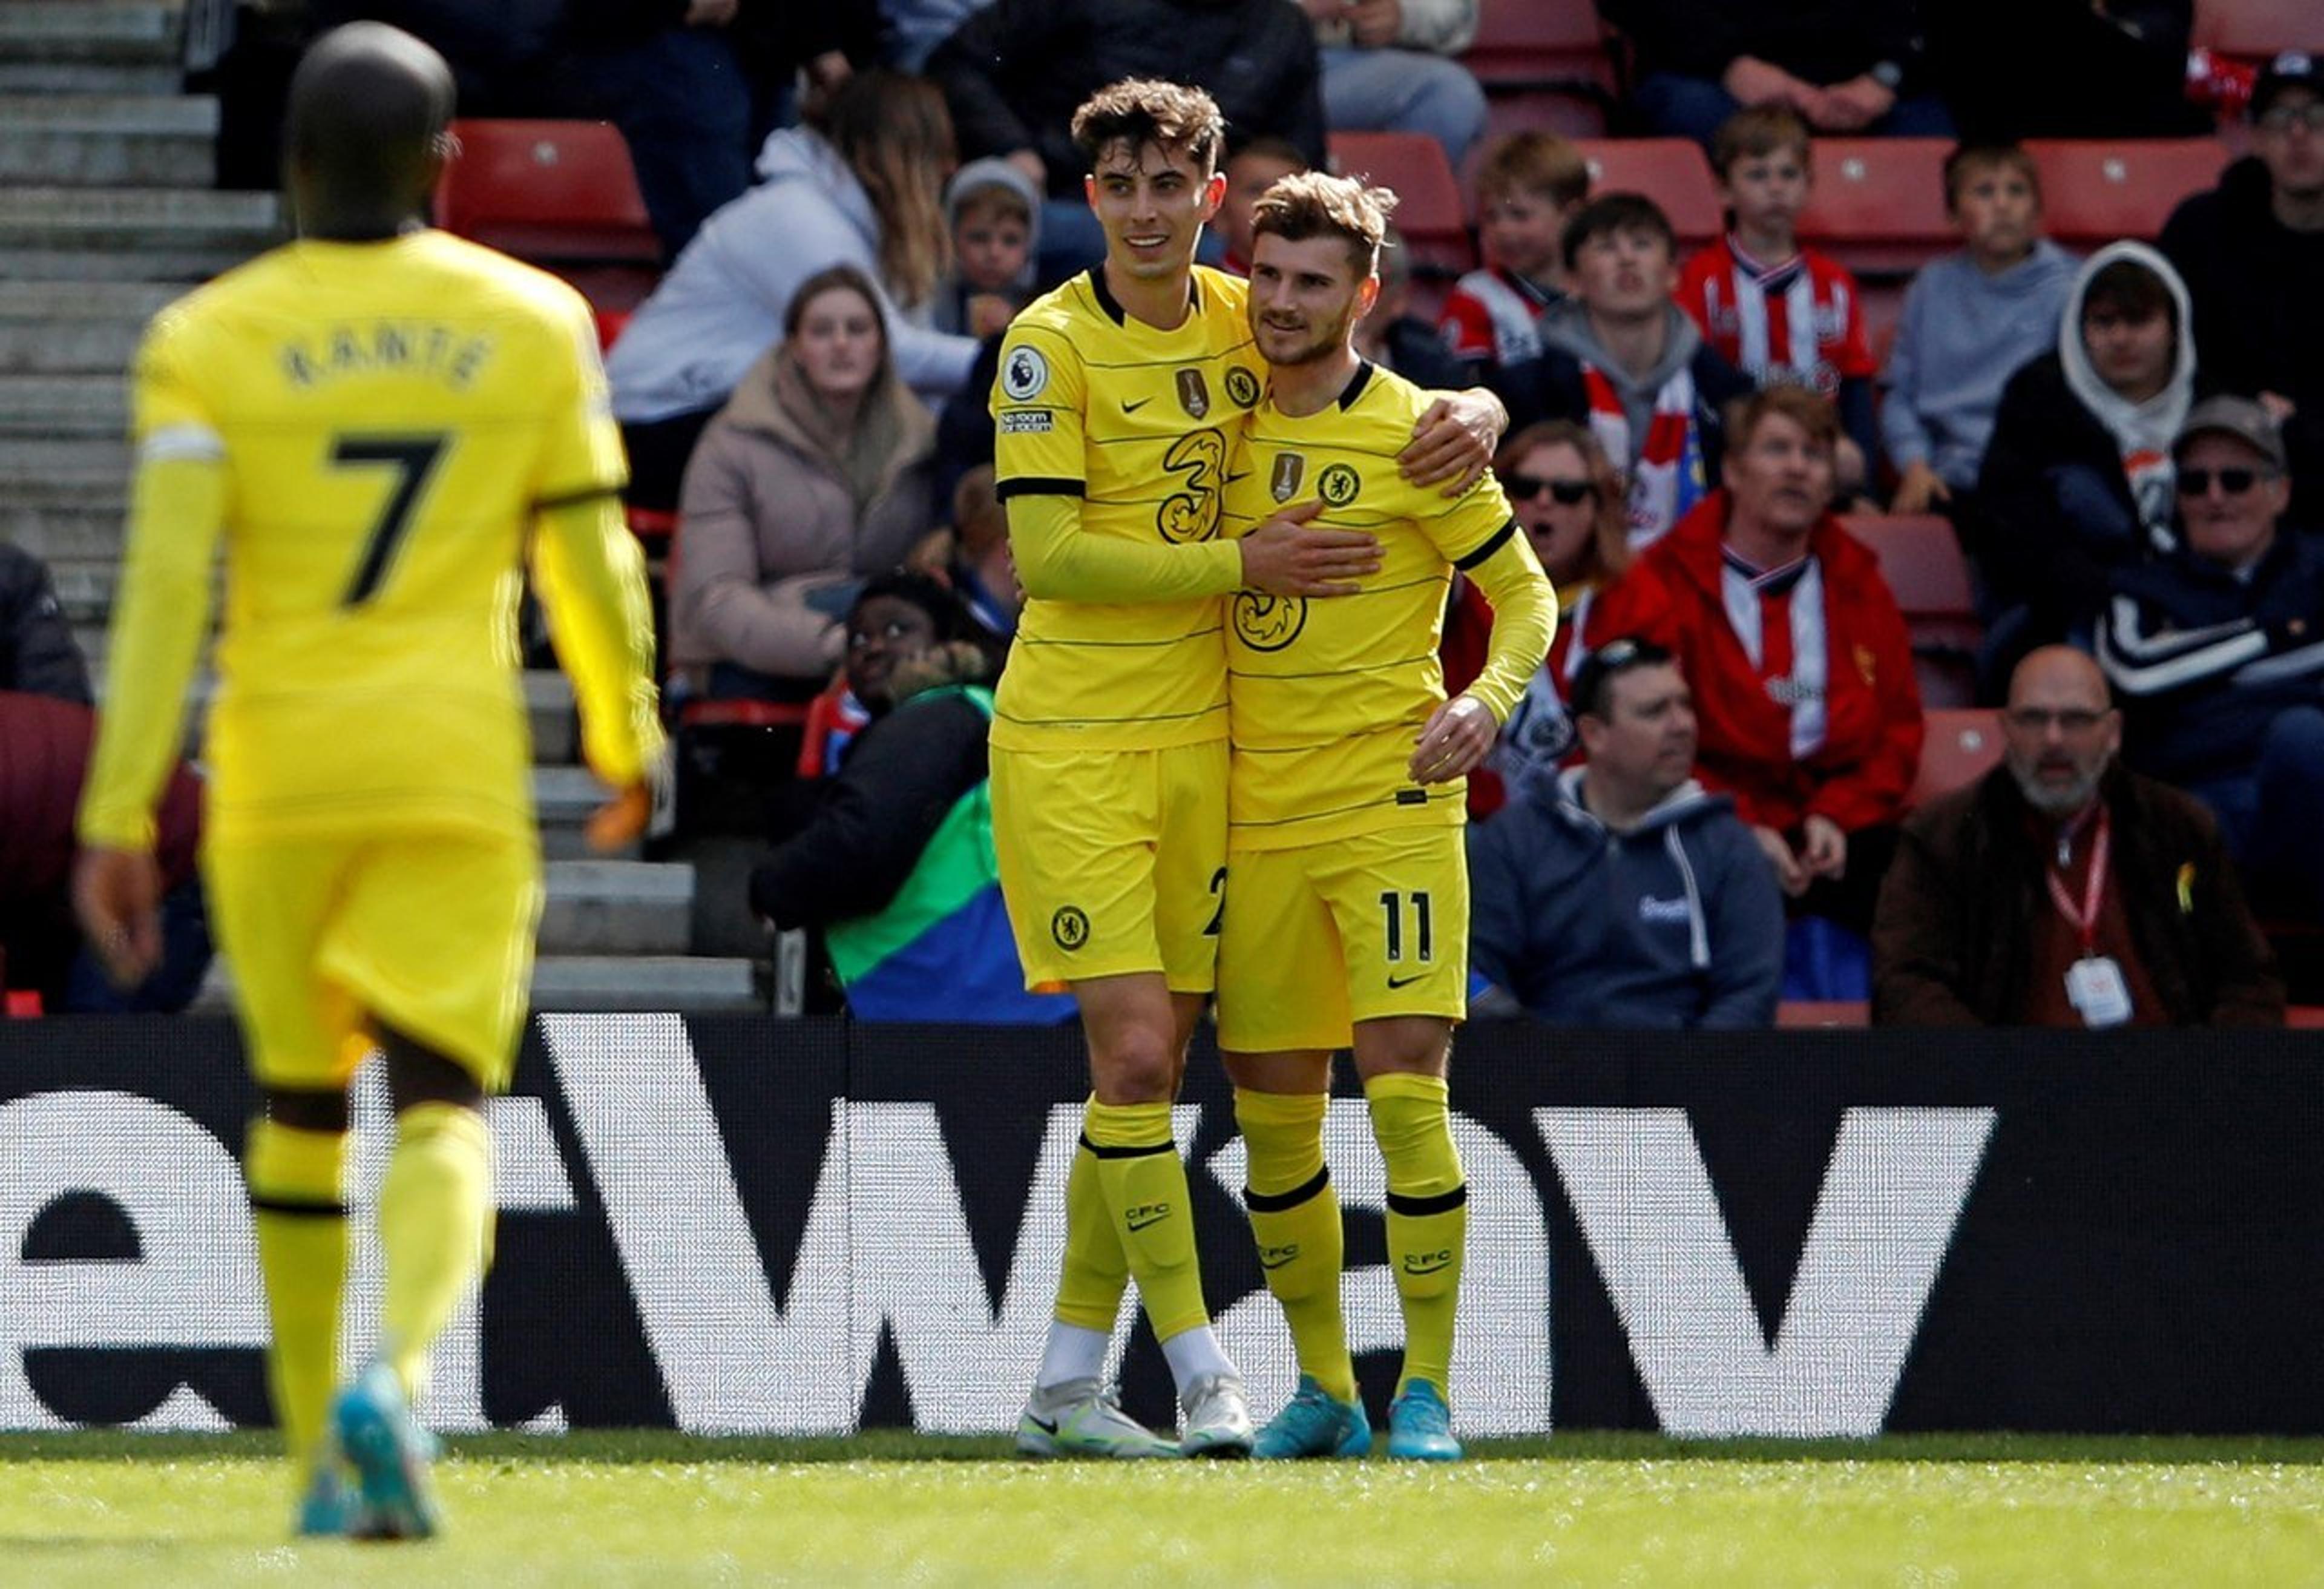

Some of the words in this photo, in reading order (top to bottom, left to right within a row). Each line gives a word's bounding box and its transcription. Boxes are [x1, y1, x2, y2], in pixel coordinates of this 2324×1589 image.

[1016, 413, 1048, 423] room
[330, 431, 451, 609] 7
[1379, 891, 1431, 961] 11
[1126, 1203, 1170, 1219] CFC
[1405, 1249, 1451, 1265] CFC
